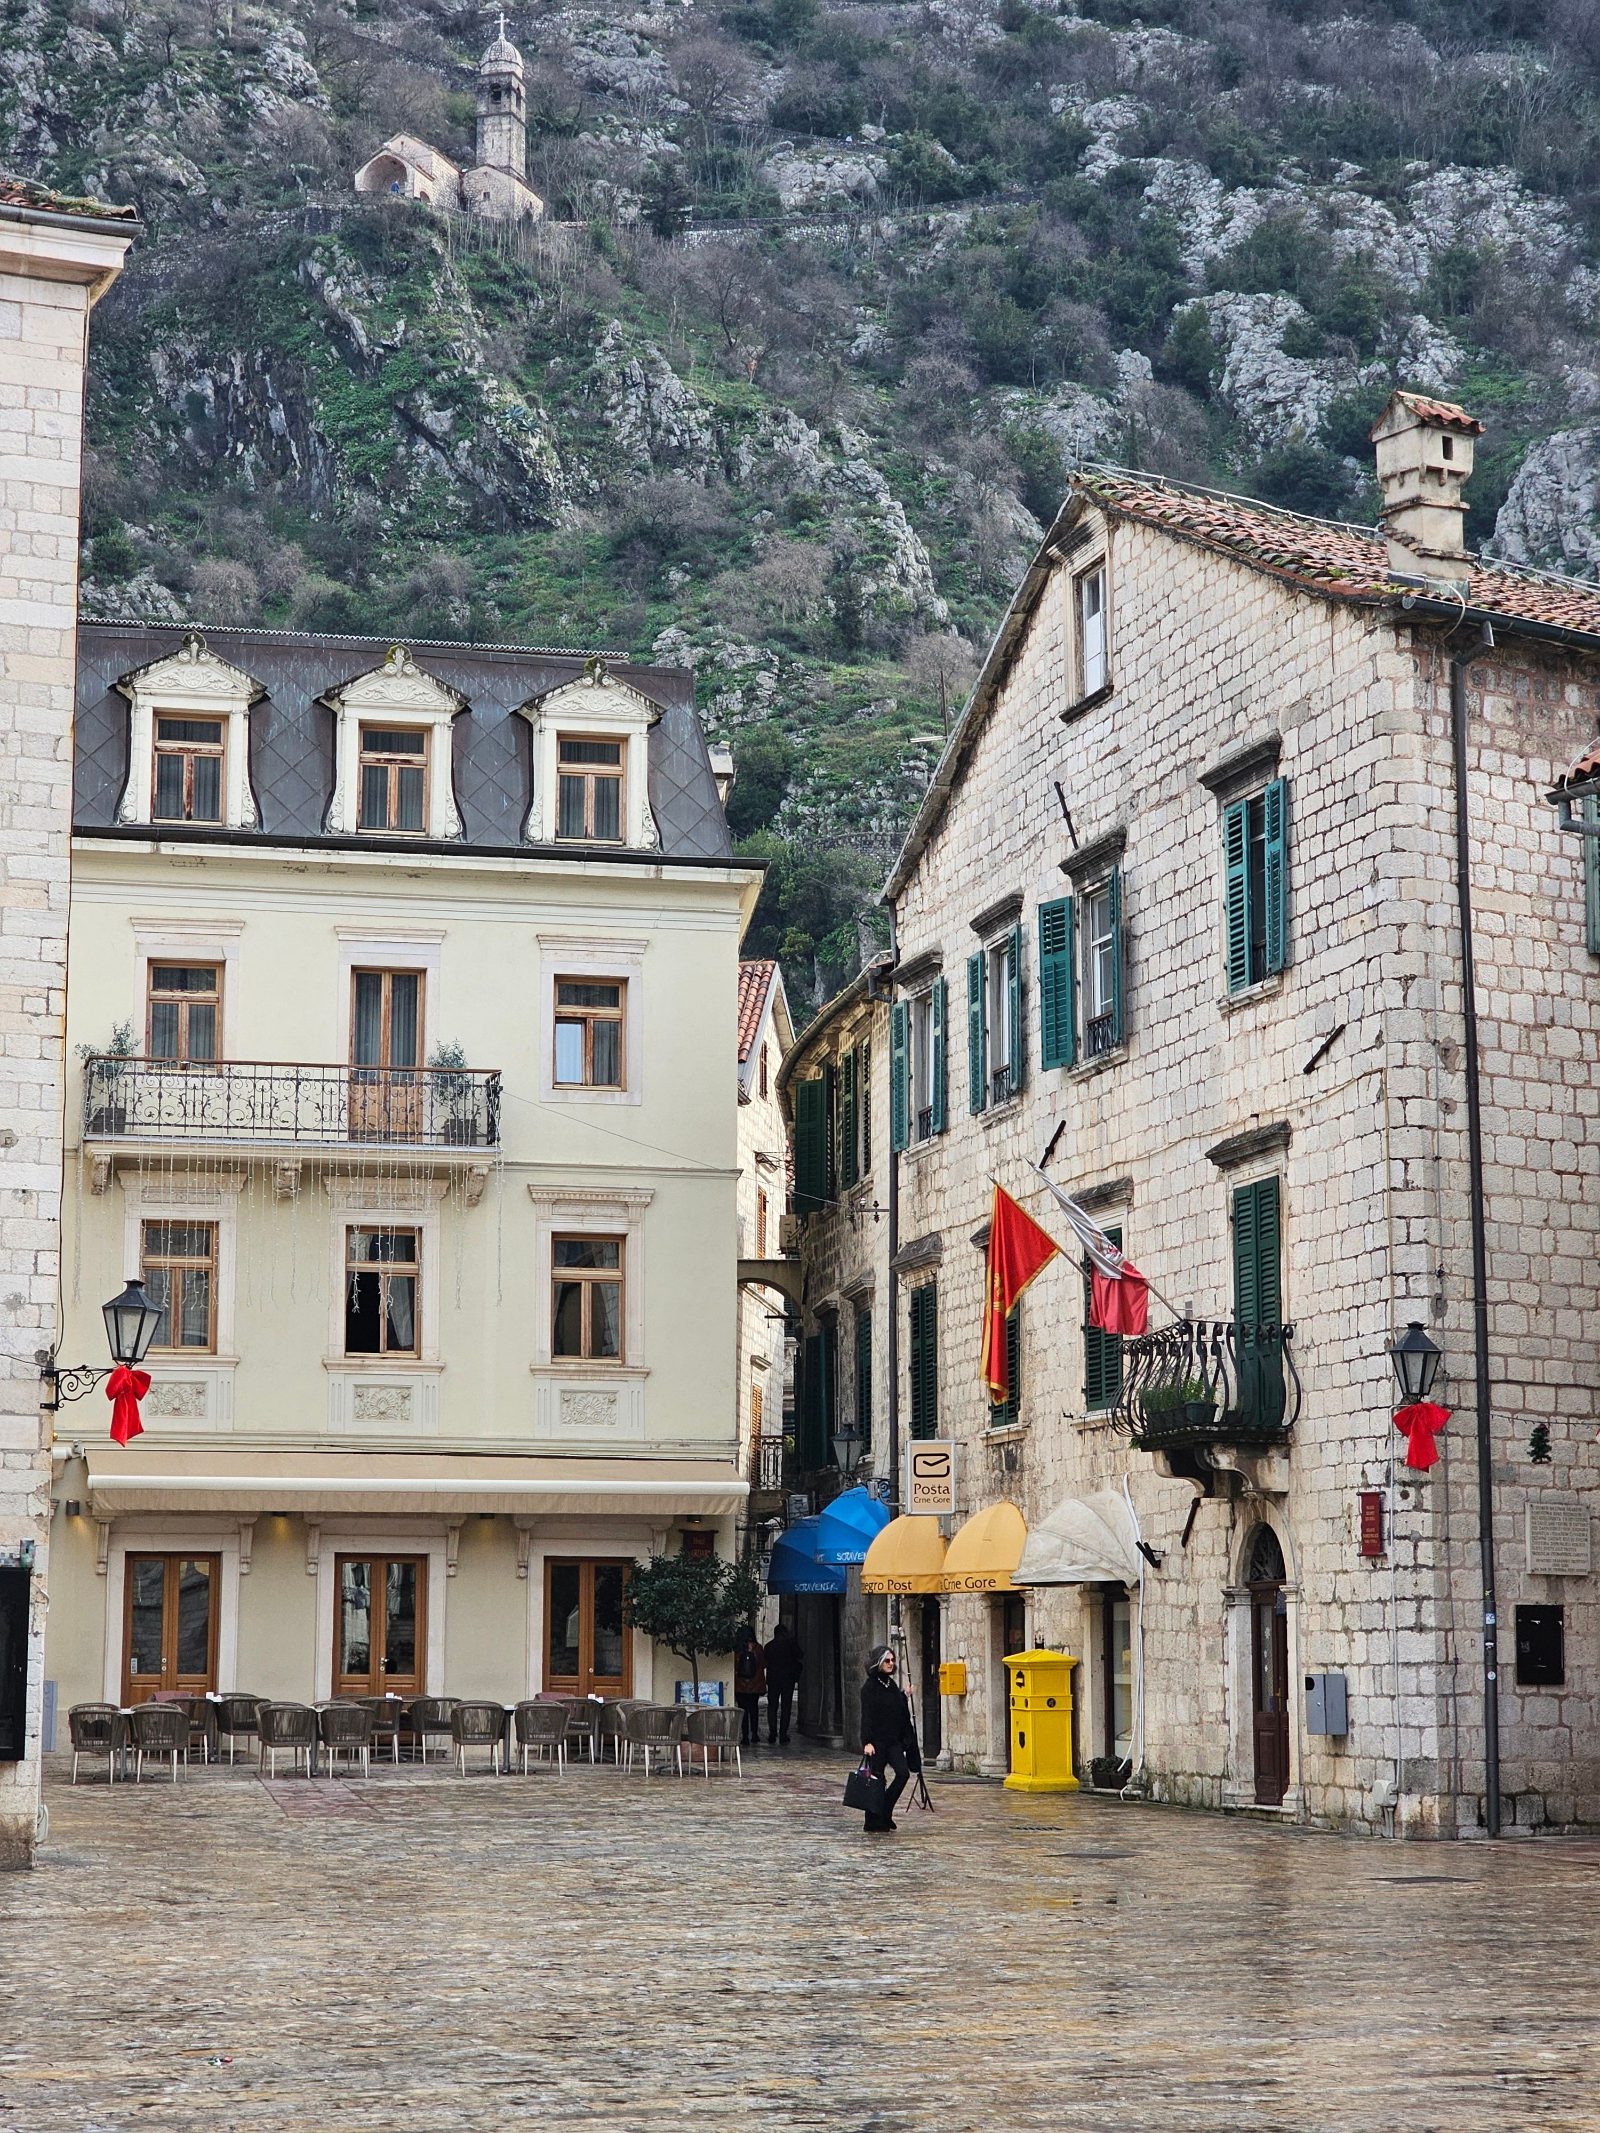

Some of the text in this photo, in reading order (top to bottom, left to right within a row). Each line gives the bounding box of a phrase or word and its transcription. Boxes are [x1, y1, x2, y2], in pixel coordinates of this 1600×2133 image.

[914, 1496, 951, 1504] Crne Gore
[887, 1579, 912, 1591] Post
[943, 1578, 962, 1590] Crne
[964, 1576, 997, 1589] Gore
